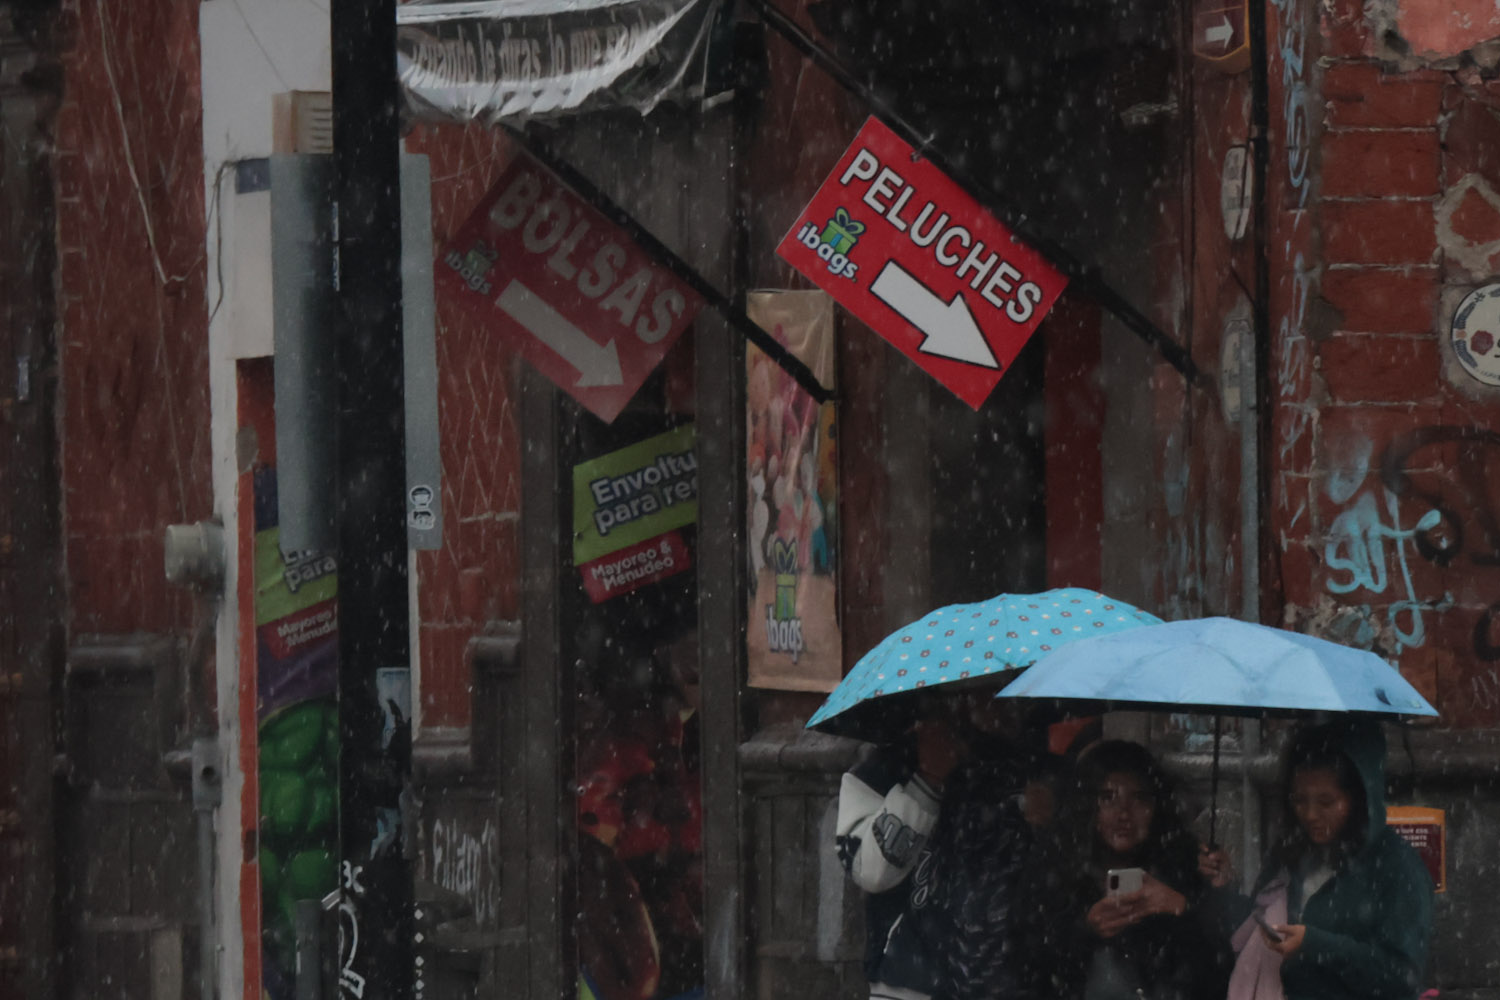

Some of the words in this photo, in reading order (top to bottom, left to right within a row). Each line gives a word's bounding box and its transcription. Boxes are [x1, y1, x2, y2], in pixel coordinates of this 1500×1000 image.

[796, 221, 860, 282] ibags
[840, 147, 1043, 324] PELUCHES
[489, 171, 686, 346] BOLSAS
[596, 494, 658, 535] para
[286, 556, 337, 592] para
[591, 549, 657, 580] Mayoreo
[602, 557, 675, 591] Menudeo
